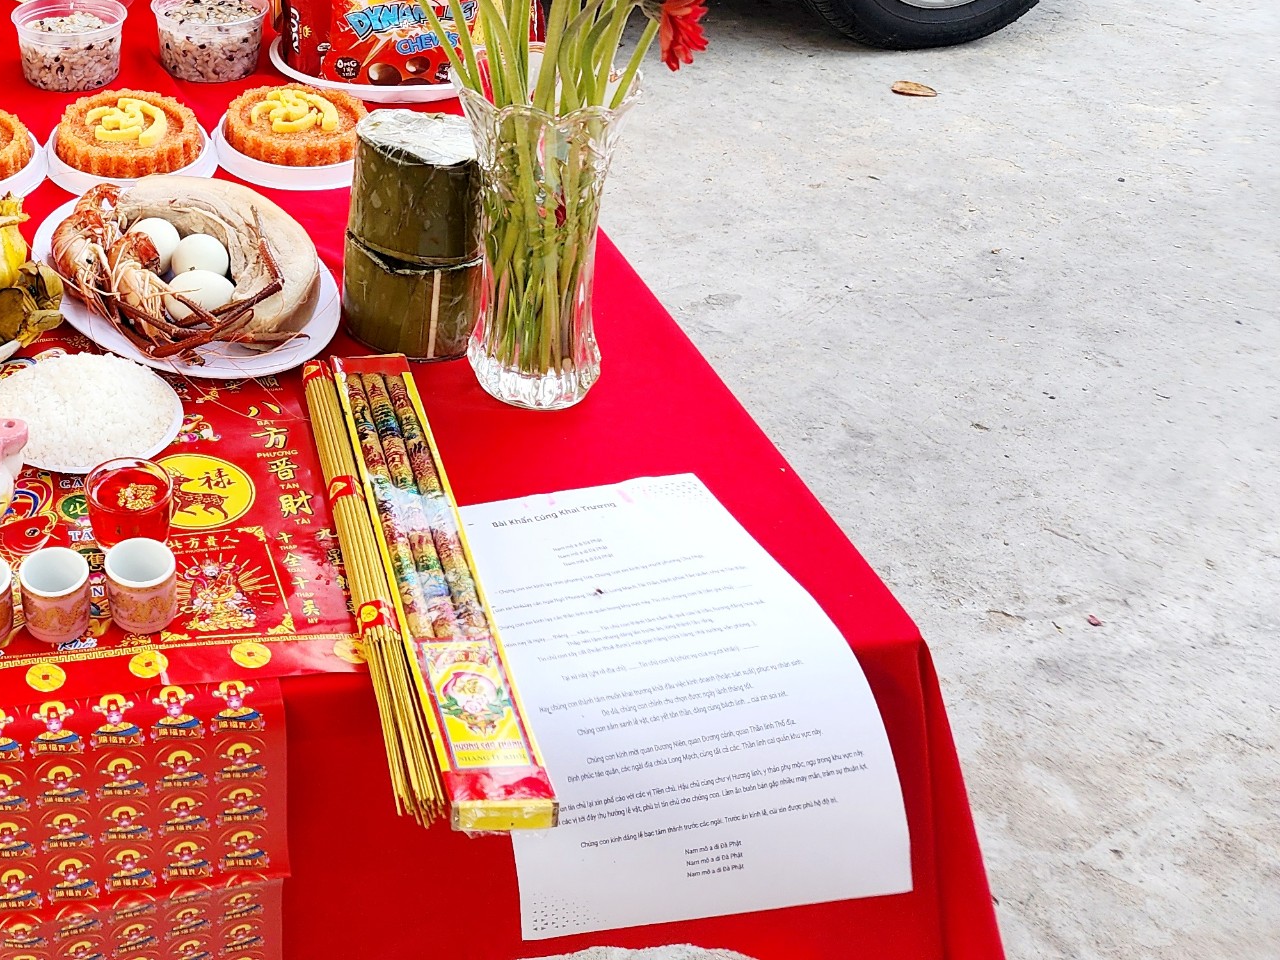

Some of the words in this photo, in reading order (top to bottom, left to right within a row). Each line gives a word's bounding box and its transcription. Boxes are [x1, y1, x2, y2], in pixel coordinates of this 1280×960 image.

[250, 427, 289, 448] 方
[279, 490, 314, 518] 財
[276, 532, 293, 543] 十
[282, 552, 305, 566] 全
[291, 576, 310, 590] 十
